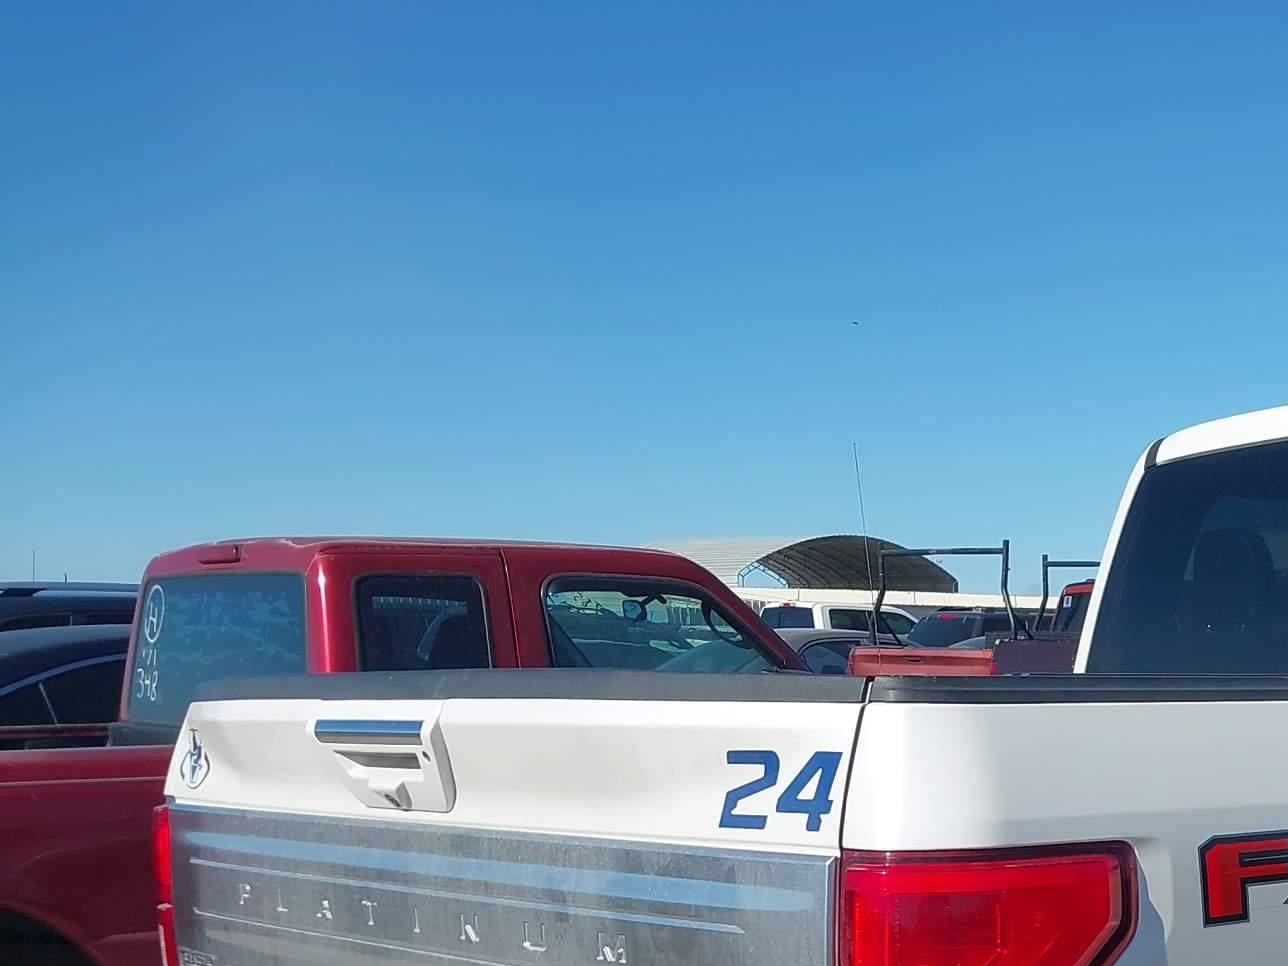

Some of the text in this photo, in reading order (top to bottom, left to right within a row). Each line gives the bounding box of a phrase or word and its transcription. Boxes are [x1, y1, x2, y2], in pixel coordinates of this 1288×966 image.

[136, 668, 158, 701] 348
[719, 750, 843, 831] 24
[238, 882, 629, 965] PLATINUM
